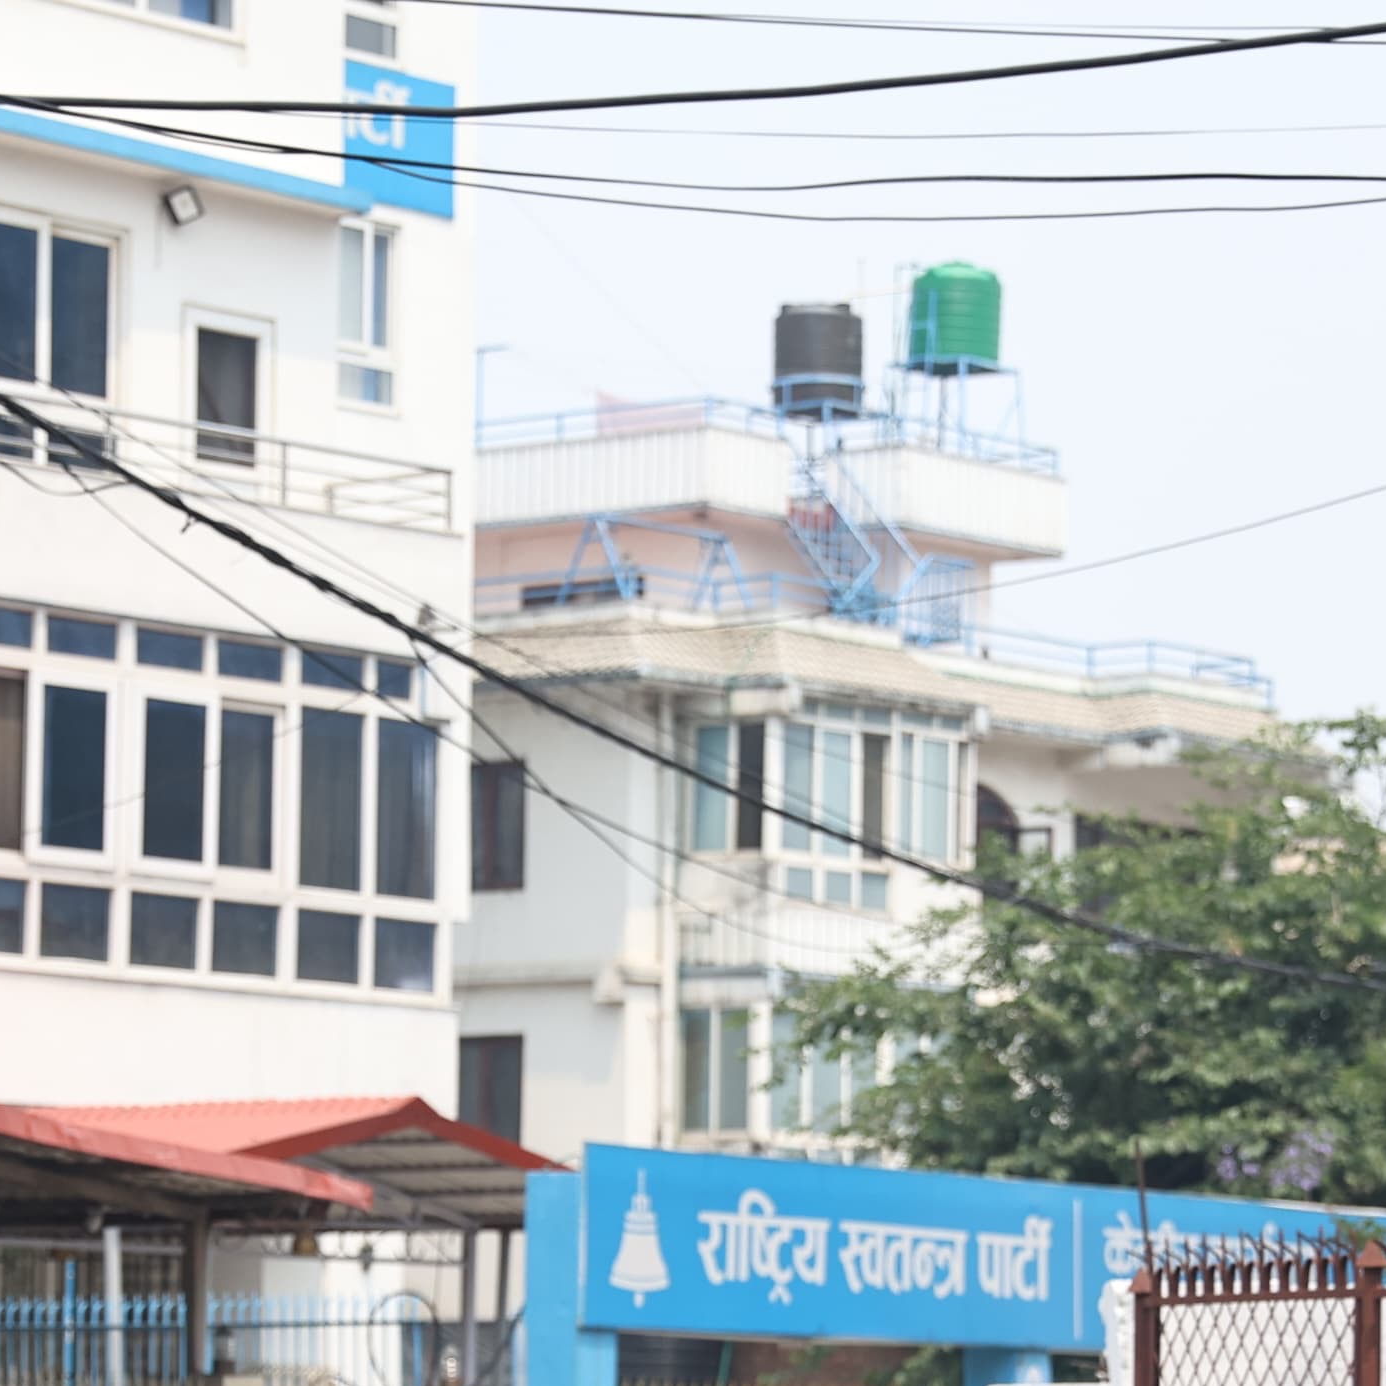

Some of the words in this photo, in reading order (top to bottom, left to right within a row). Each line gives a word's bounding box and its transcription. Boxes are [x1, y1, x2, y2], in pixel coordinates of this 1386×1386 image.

[697, 1189, 831, 1304] राष्ट्रिय
[839, 1219, 968, 1299] स्वतन्त्र
[976, 1214, 1052, 1302] पार्टी
